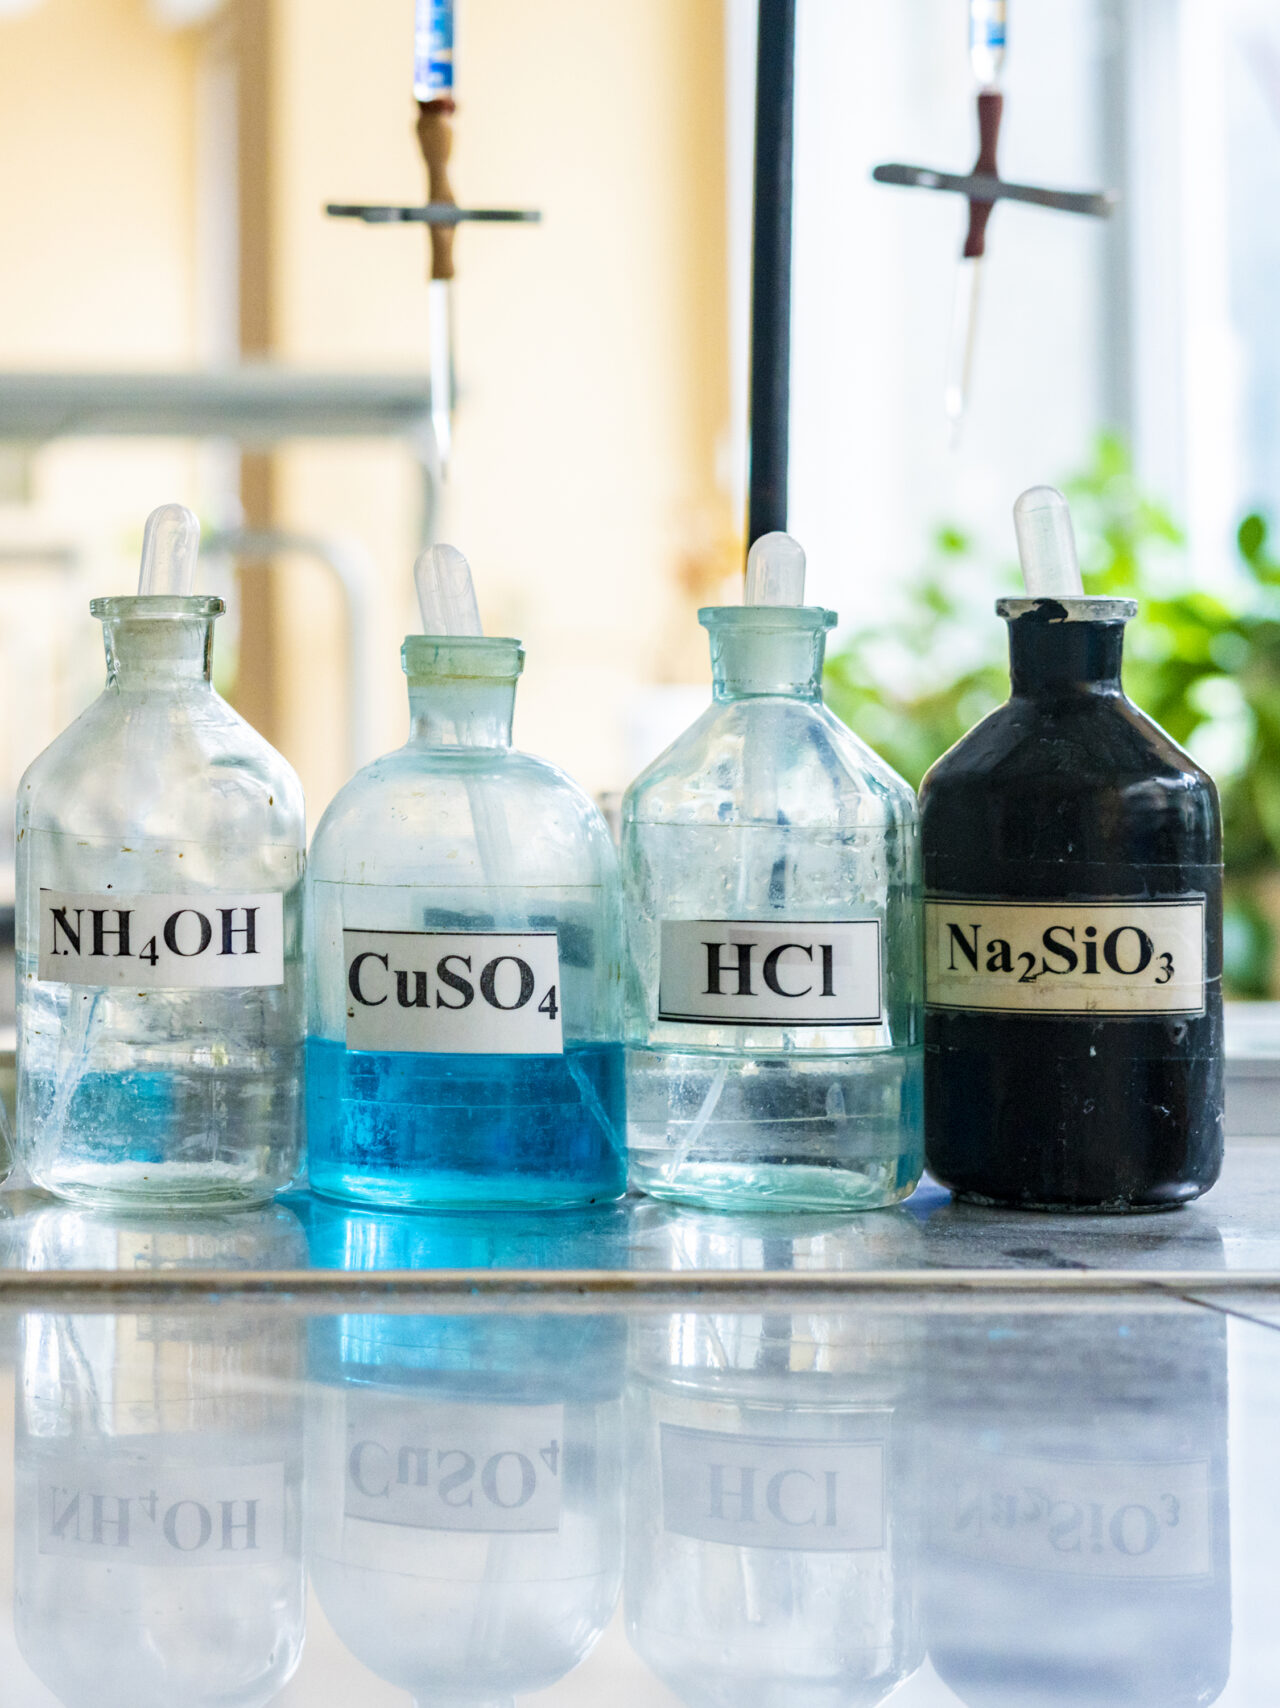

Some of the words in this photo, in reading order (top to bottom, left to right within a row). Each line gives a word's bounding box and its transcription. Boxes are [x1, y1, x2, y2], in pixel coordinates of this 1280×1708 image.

[50, 907, 260, 967] NH4OH
[946, 922, 1175, 984] Na2SiO3
[347, 951, 559, 1020] CuSO4
[700, 941, 837, 998] HCl
